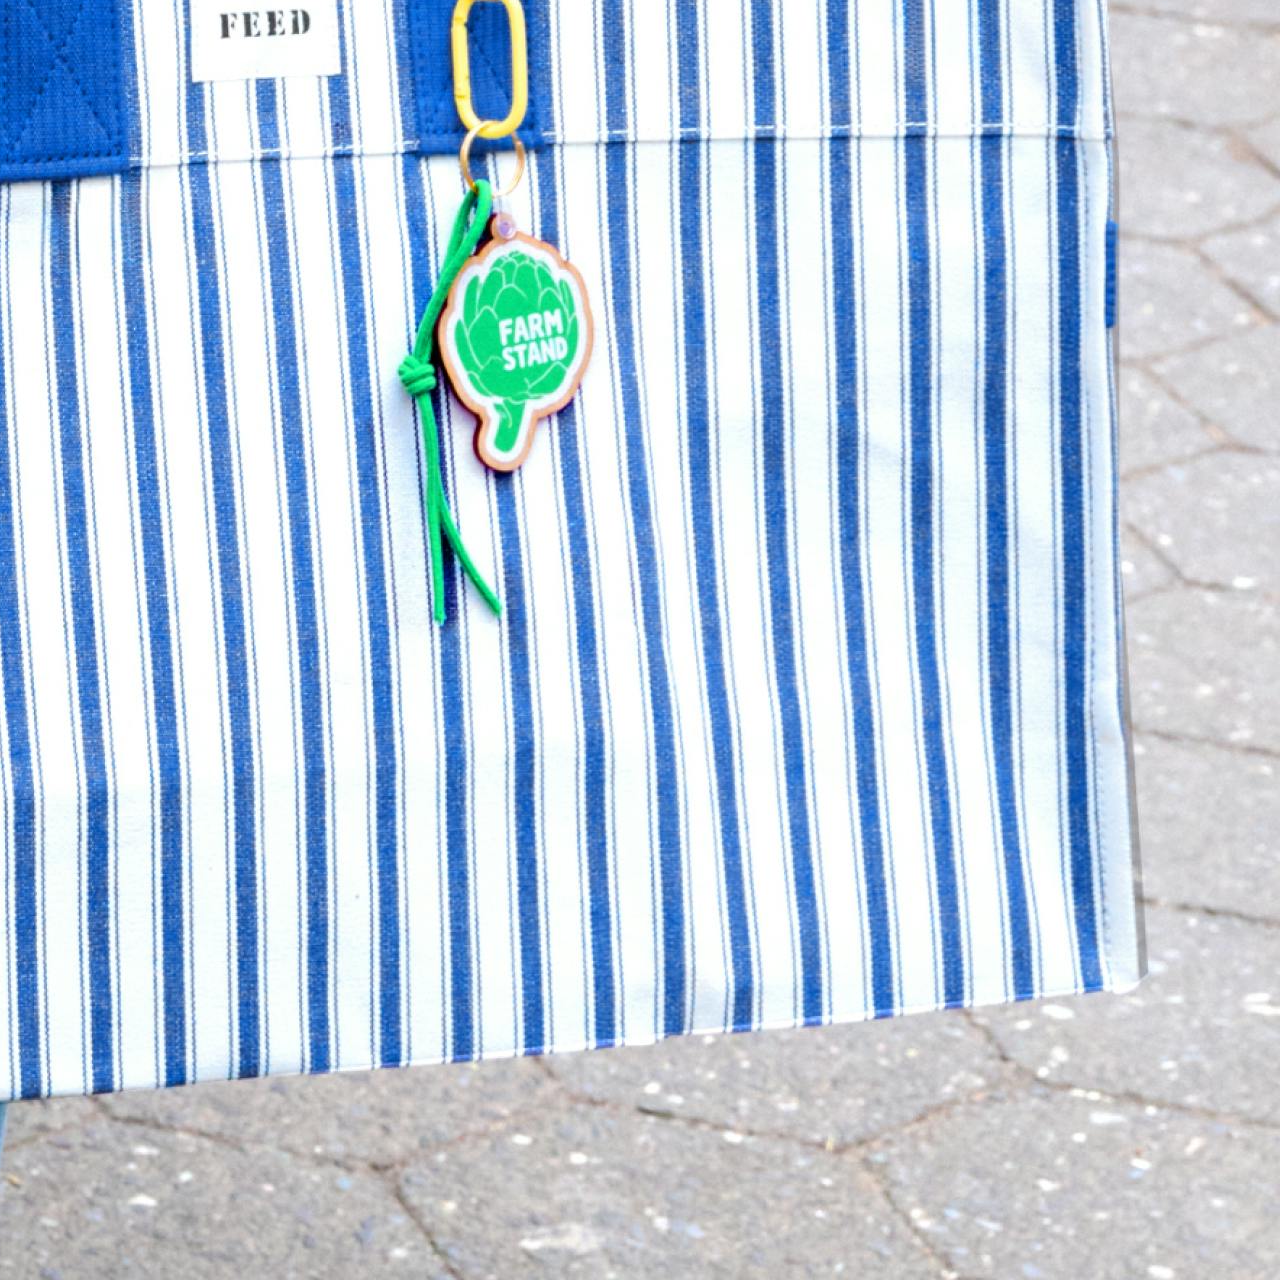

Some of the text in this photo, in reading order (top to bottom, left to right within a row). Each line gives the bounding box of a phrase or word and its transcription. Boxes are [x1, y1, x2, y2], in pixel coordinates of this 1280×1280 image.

[220, 9, 311, 39] FEED
[498, 308, 564, 345] FARM
[502, 337, 568, 371] STAND
